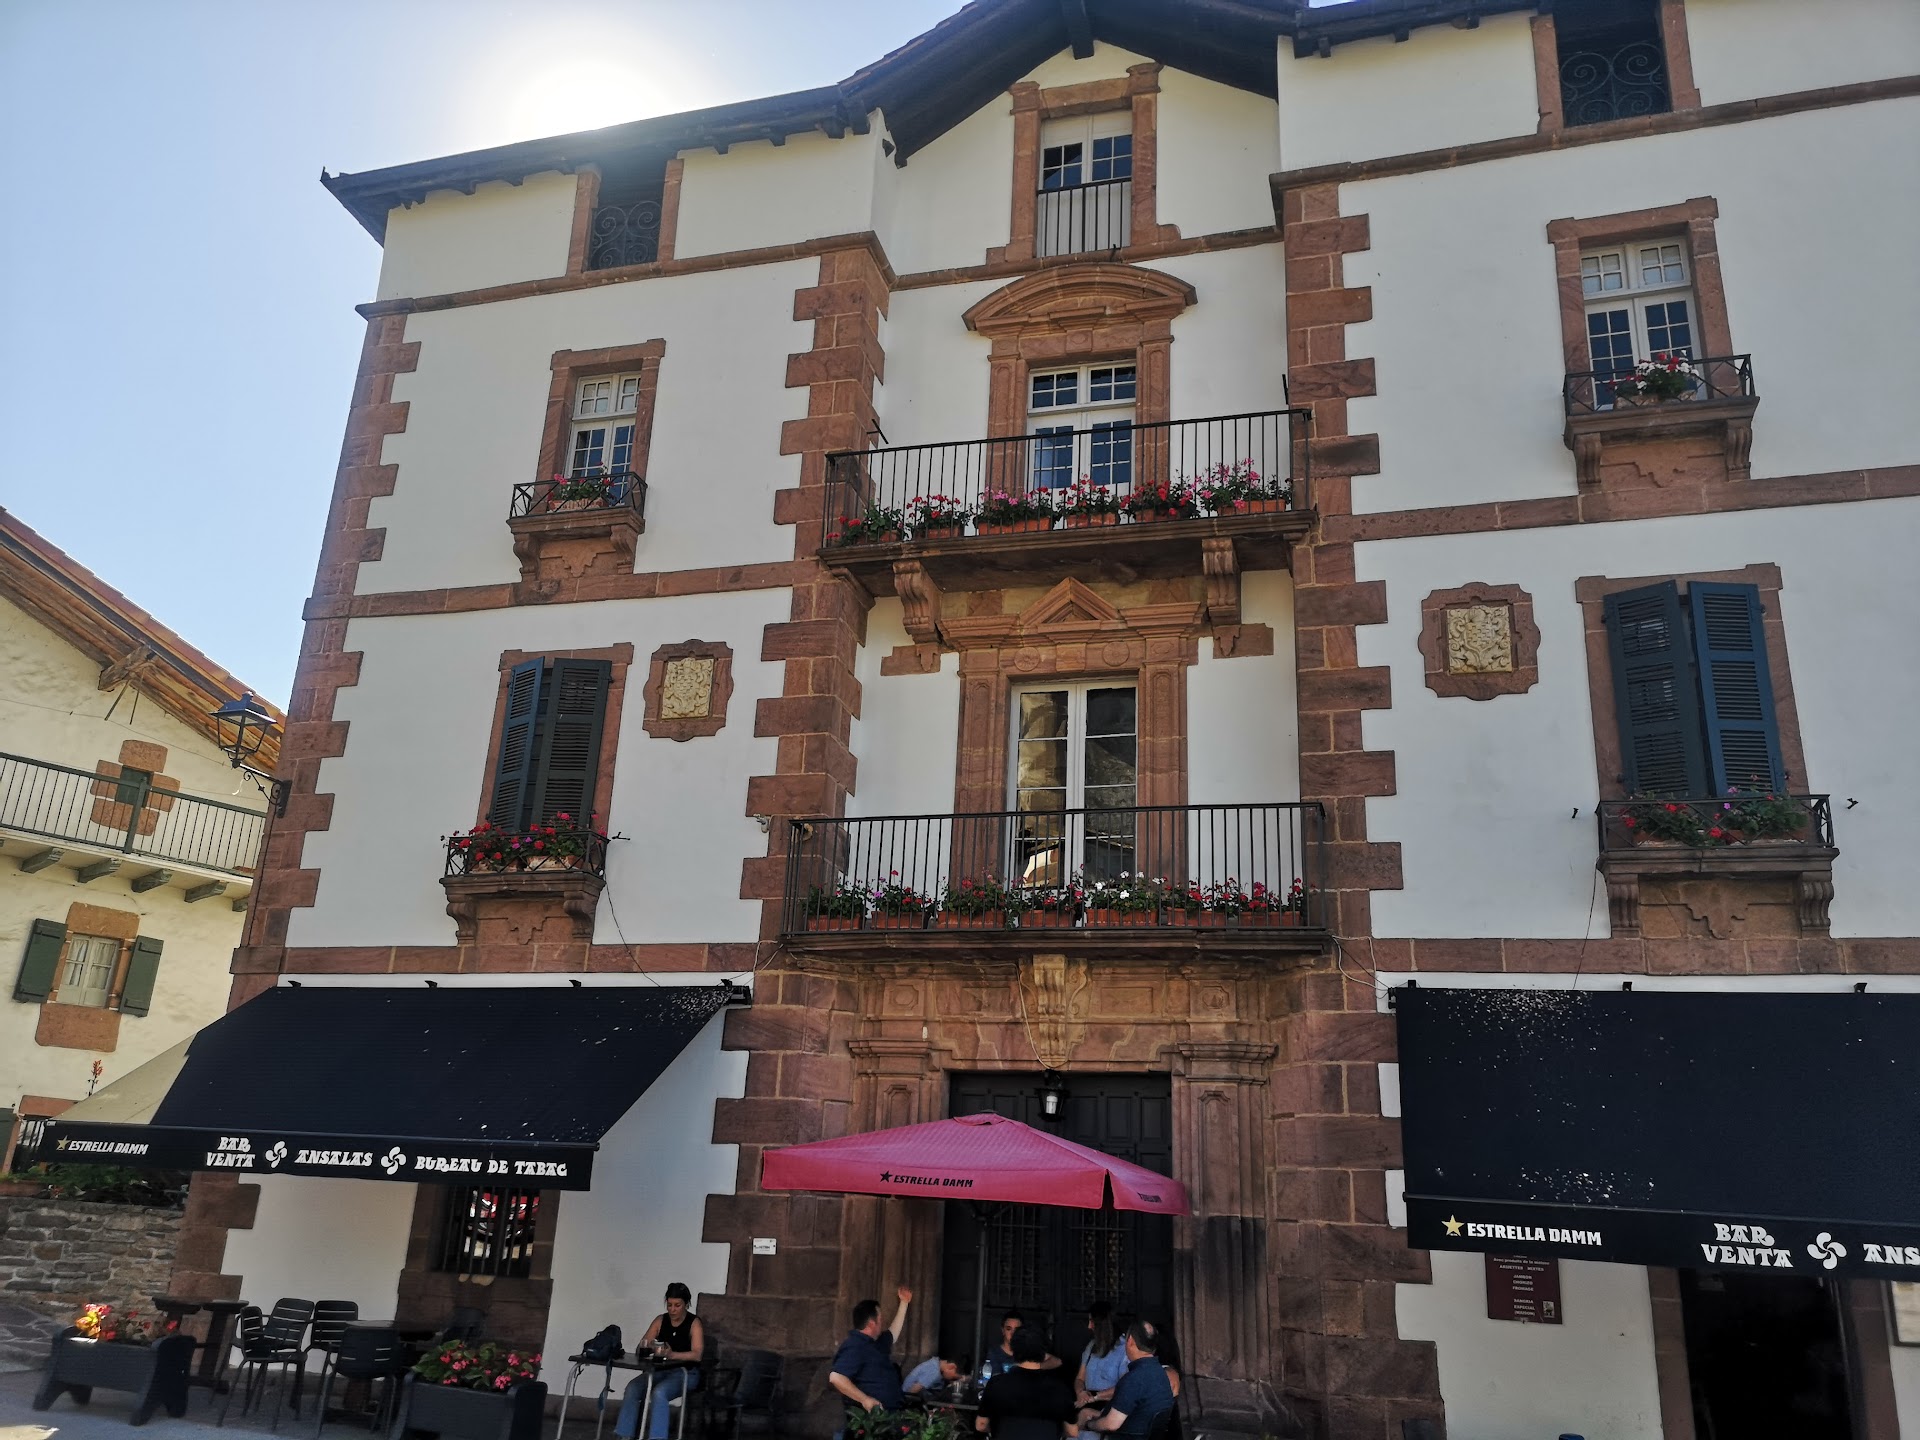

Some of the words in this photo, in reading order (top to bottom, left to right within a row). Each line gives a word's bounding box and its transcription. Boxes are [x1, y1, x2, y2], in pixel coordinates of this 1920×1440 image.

[68, 1140, 115, 1153] ESTRELLA
[114, 1142, 149, 1155] DAMM
[218, 1136, 251, 1153] BAR
[205, 1151, 256, 1168] VENTA
[294, 1150, 374, 1167] ANSALAS
[414, 1155, 483, 1173] BUREAU
[487, 1159, 509, 1174] DE
[514, 1160, 568, 1177] TABAC
[893, 1174, 940, 1186] ESTRELLA
[942, 1178, 974, 1188] DAMM
[1466, 1222, 1546, 1242] ESTRELLA
[1548, 1228, 1603, 1246] DAMM
[1713, 1222, 1775, 1247] BAR
[1701, 1243, 1794, 1268] VENTA
